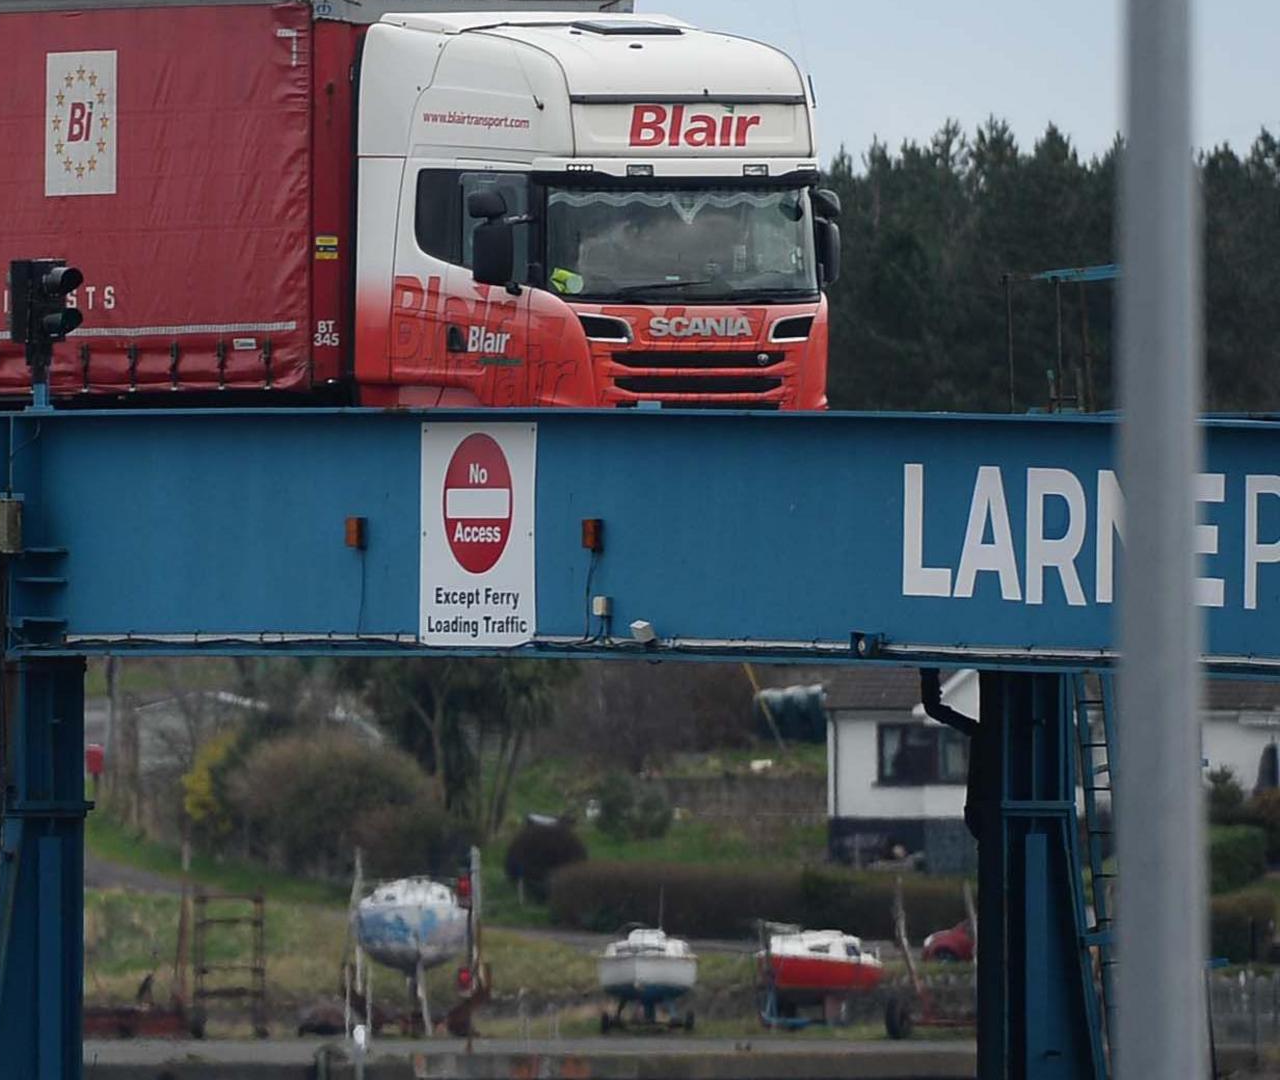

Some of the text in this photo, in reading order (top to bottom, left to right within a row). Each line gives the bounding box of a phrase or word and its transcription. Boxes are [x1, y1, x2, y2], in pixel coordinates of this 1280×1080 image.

[67, 101, 94, 143] Bi
[628, 104, 761, 147] Blair
[317, 320, 335, 333] BT
[648, 317, 753, 337] SCANIA
[313, 333, 340, 347] 345
[467, 325, 511, 354] Blair
[469, 463, 488, 484] No
[453, 522, 501, 543] Access
[435, 587, 520, 610] Except Ferry
[428, 615, 528, 638] Loading Traffic
